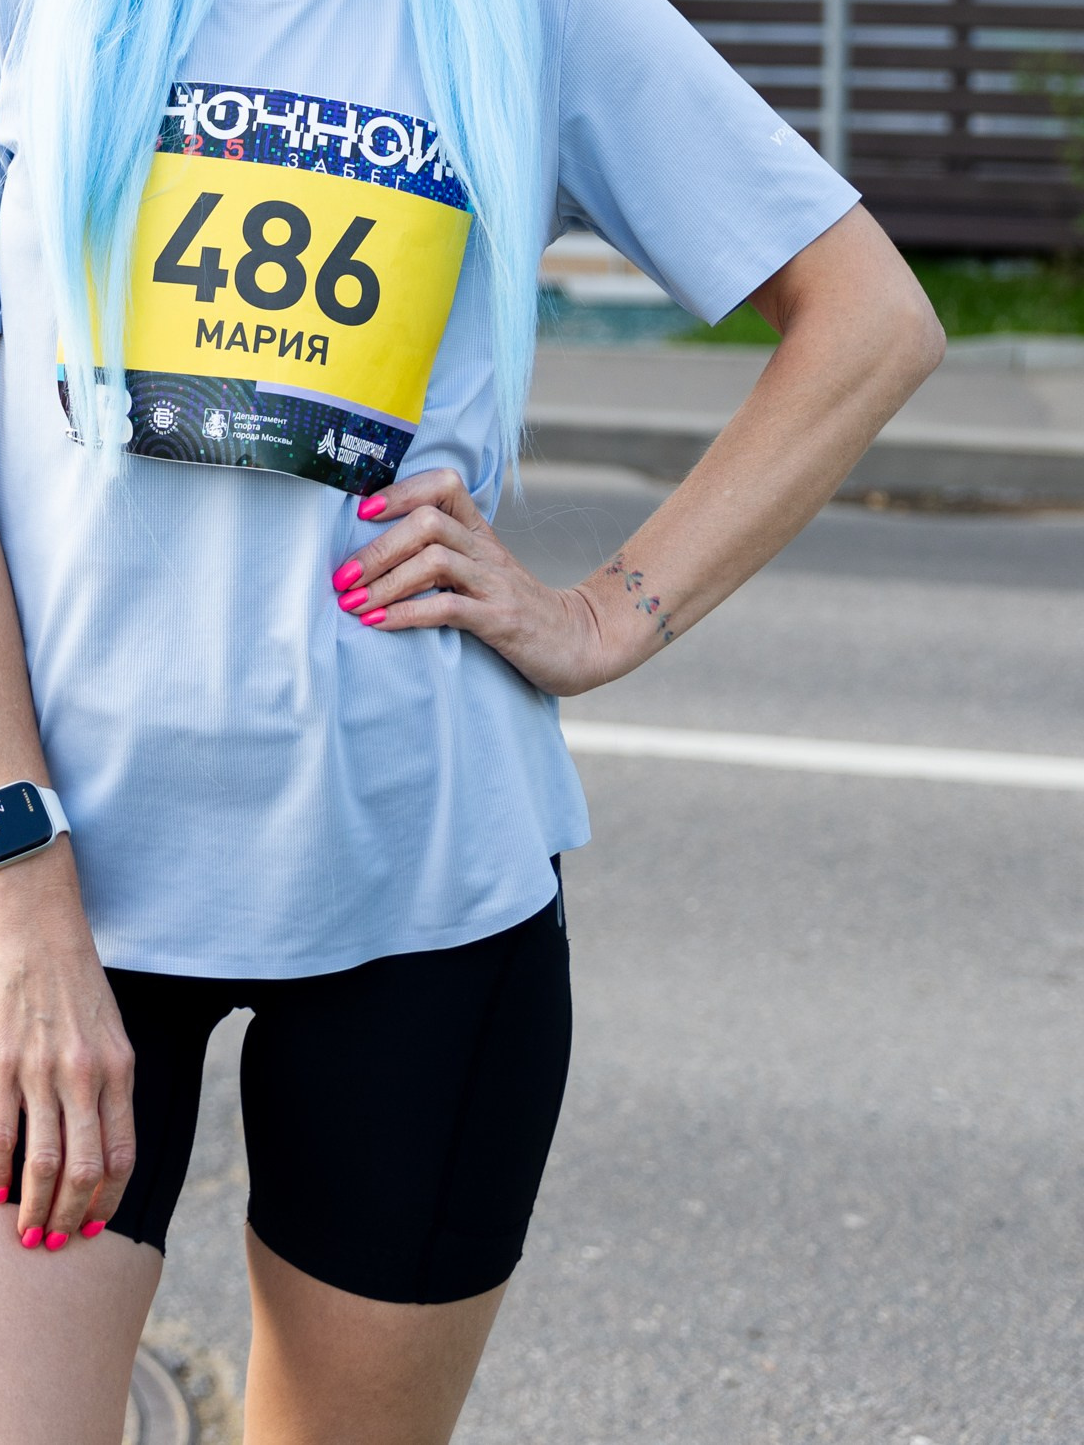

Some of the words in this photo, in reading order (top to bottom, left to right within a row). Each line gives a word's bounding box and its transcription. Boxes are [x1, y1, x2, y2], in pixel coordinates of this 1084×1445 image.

[286, 152, 406, 191] ЗАБЕГ
[153, 191, 381, 327] 486
[195, 318, 330, 366] МАРИЯ
[234, 411, 288, 425] Департамент
[234, 422, 261, 431] спорта
[232, 431, 260, 441] города
[261, 434, 293, 446] Москвы
[336, 447, 361, 466] СПОРТ
